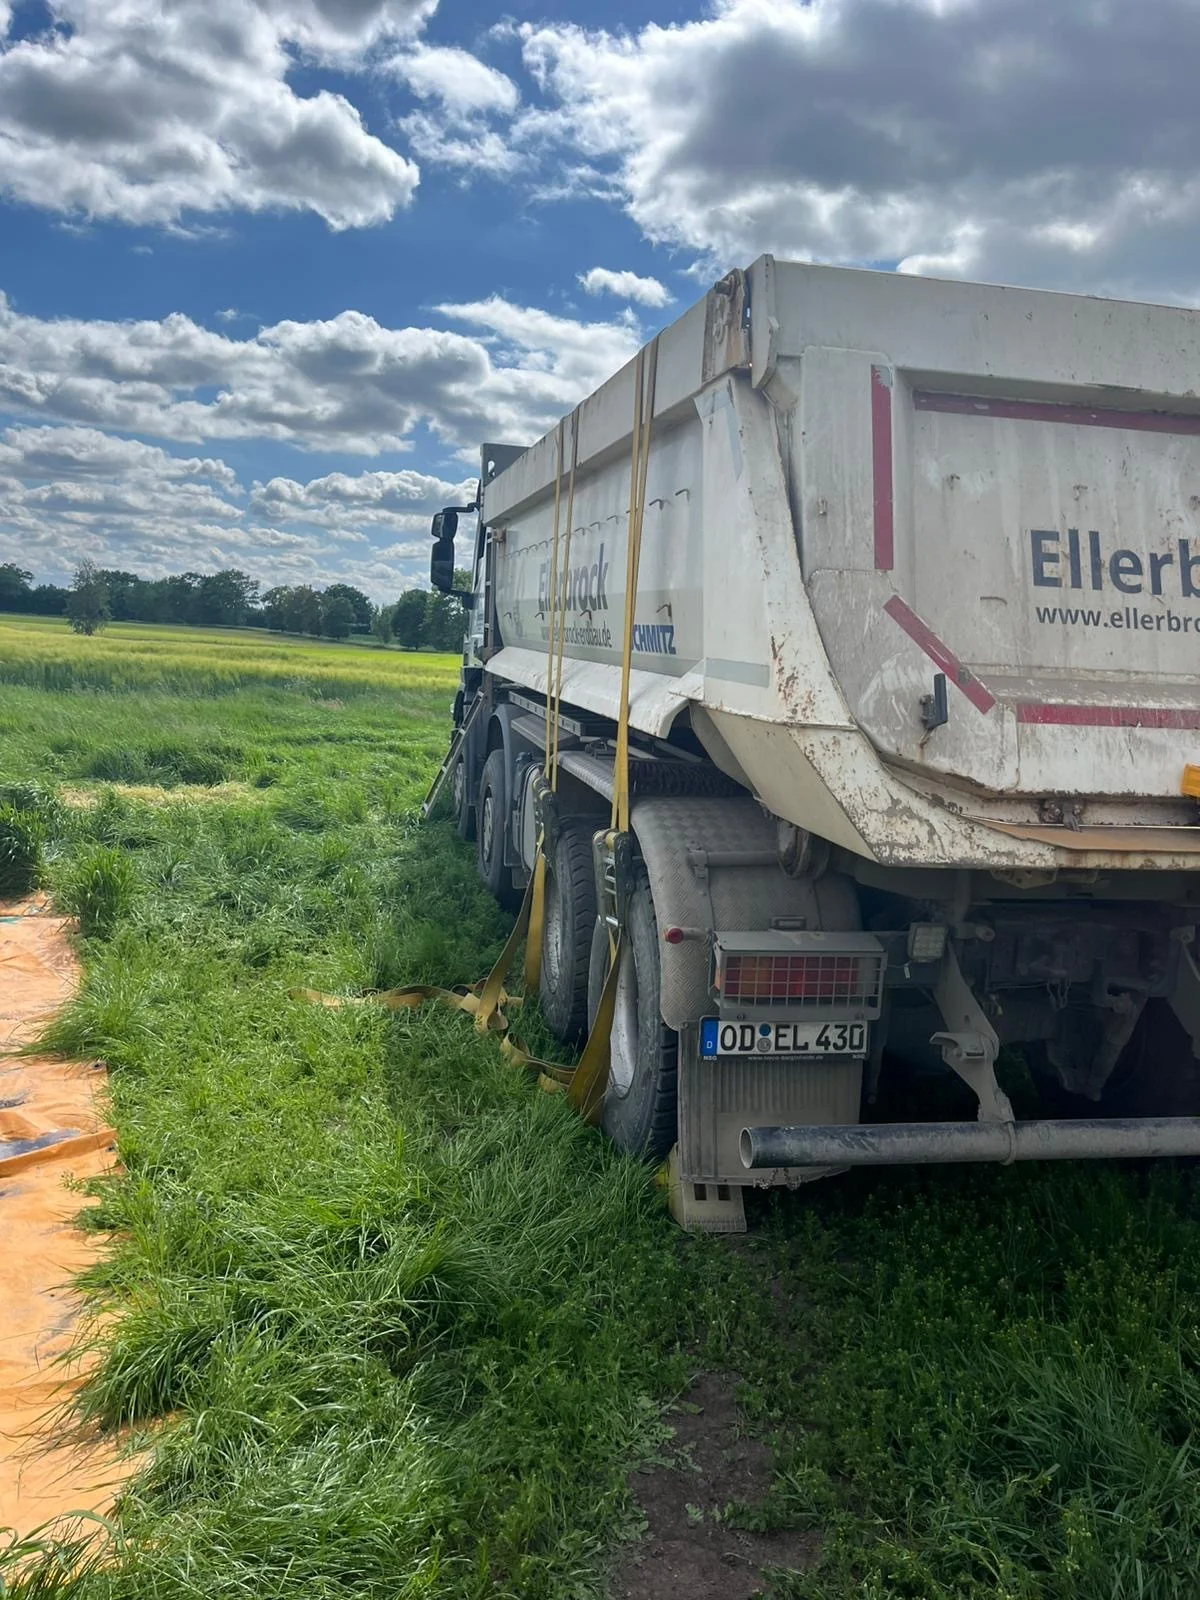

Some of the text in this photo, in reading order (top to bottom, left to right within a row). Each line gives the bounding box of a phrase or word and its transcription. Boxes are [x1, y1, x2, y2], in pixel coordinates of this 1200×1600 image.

[1030, 527, 1200, 599] Ellerb
[632, 623, 677, 655] CHMITZ
[706, 1041, 713, 1049] D
[720, 1023, 864, 1051] OD EL 430
